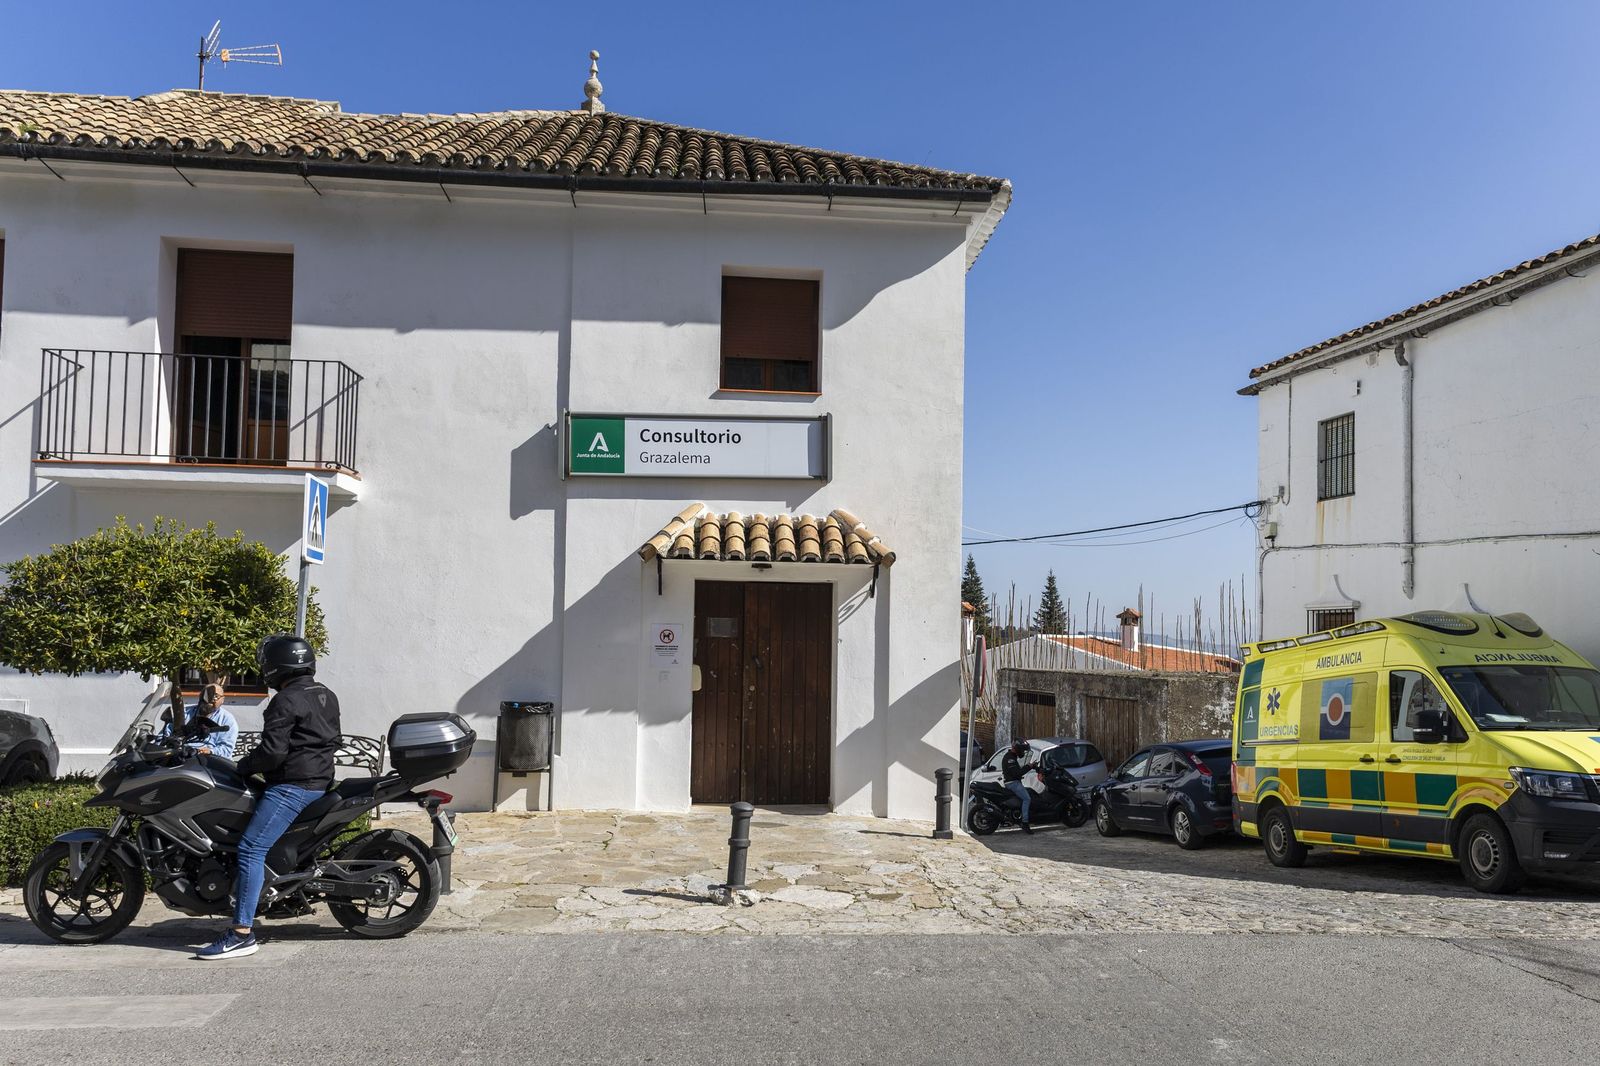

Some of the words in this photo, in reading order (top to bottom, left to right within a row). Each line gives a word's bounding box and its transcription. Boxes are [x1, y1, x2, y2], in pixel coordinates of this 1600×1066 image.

[640, 428, 742, 444] Consultorio
[640, 451, 711, 464] Grazalema
[1316, 651, 1362, 669] AMBULANCIA
[1260, 724, 1299, 737] URGENCIAS
